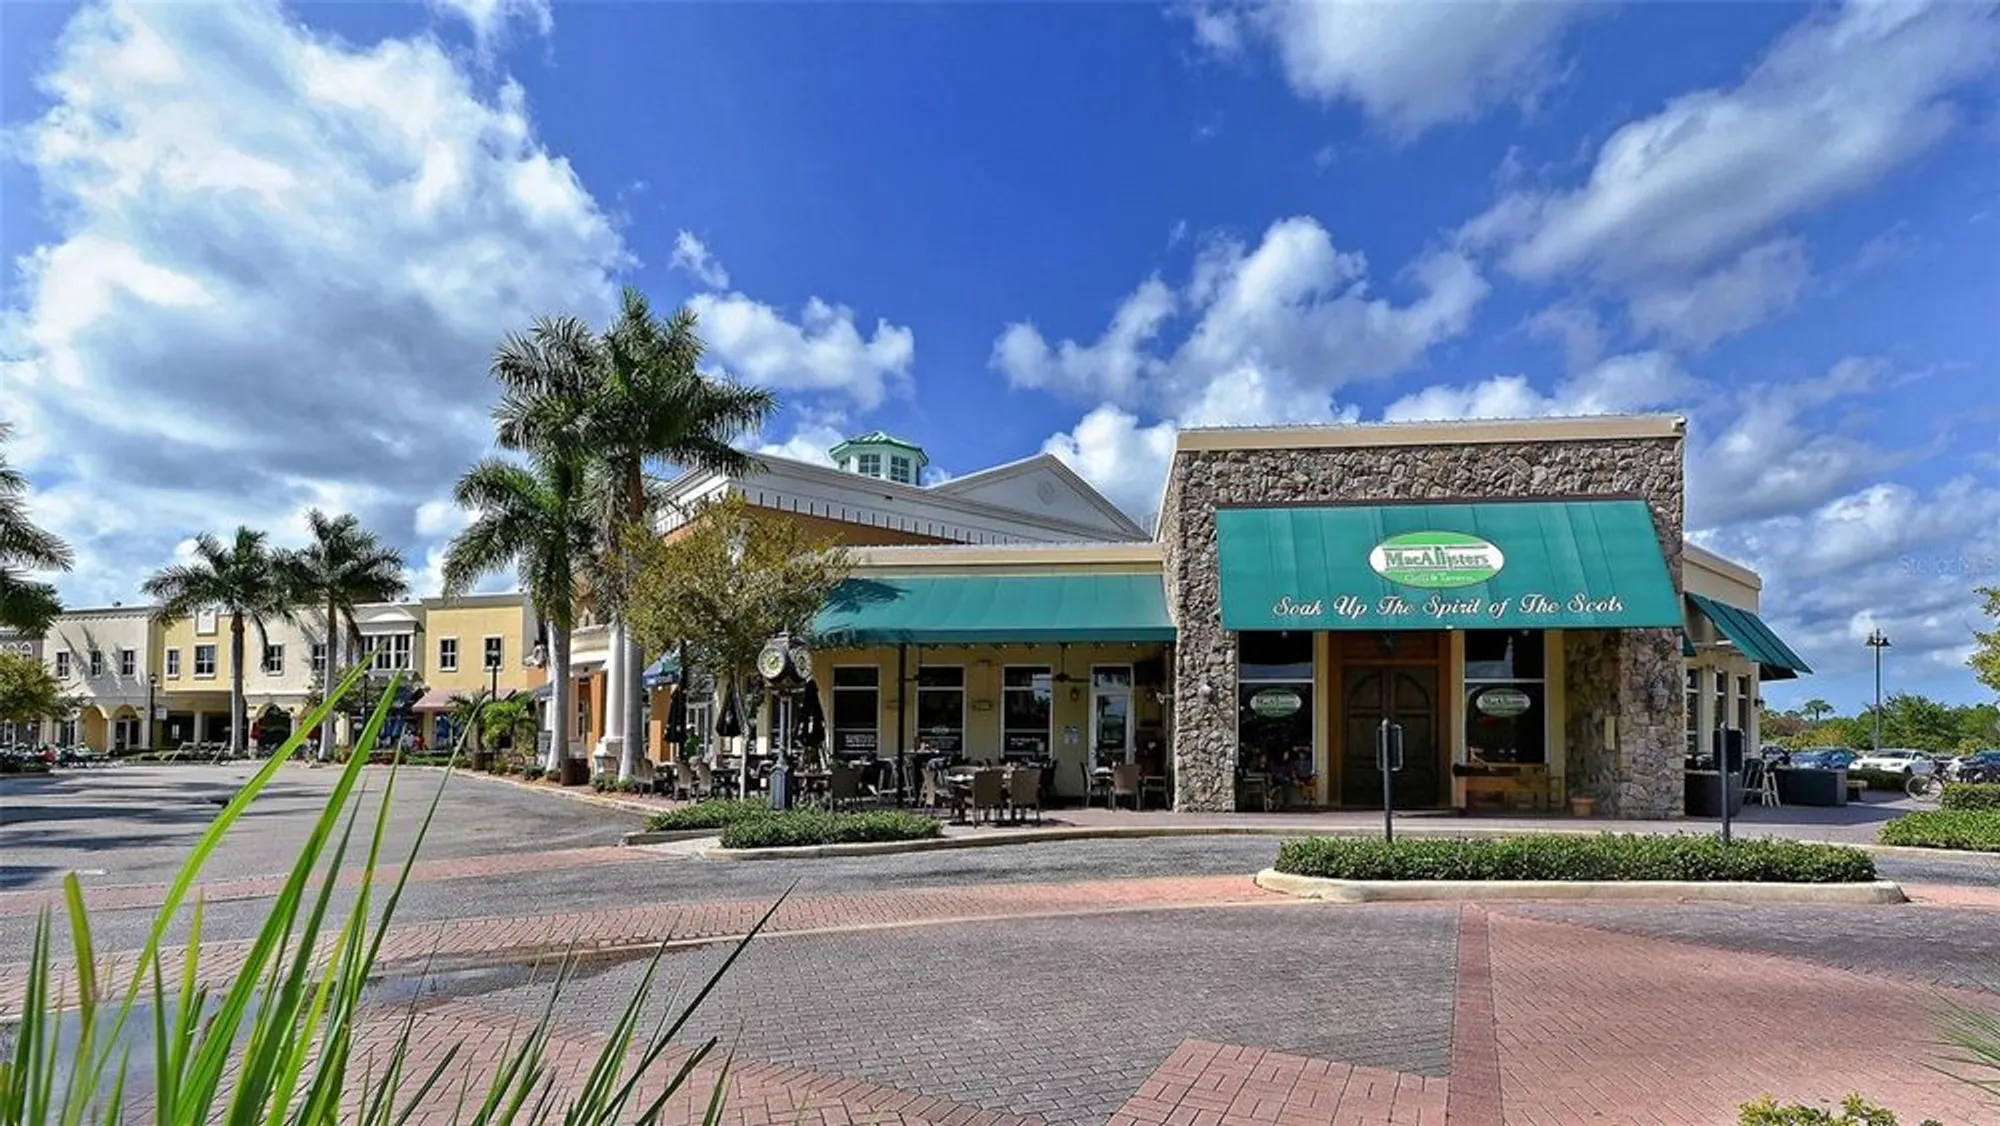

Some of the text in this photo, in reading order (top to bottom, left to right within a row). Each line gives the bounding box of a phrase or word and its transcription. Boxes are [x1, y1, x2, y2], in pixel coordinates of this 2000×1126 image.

[1272, 591, 1624, 619] Soak Up The Spirit of The Scots
